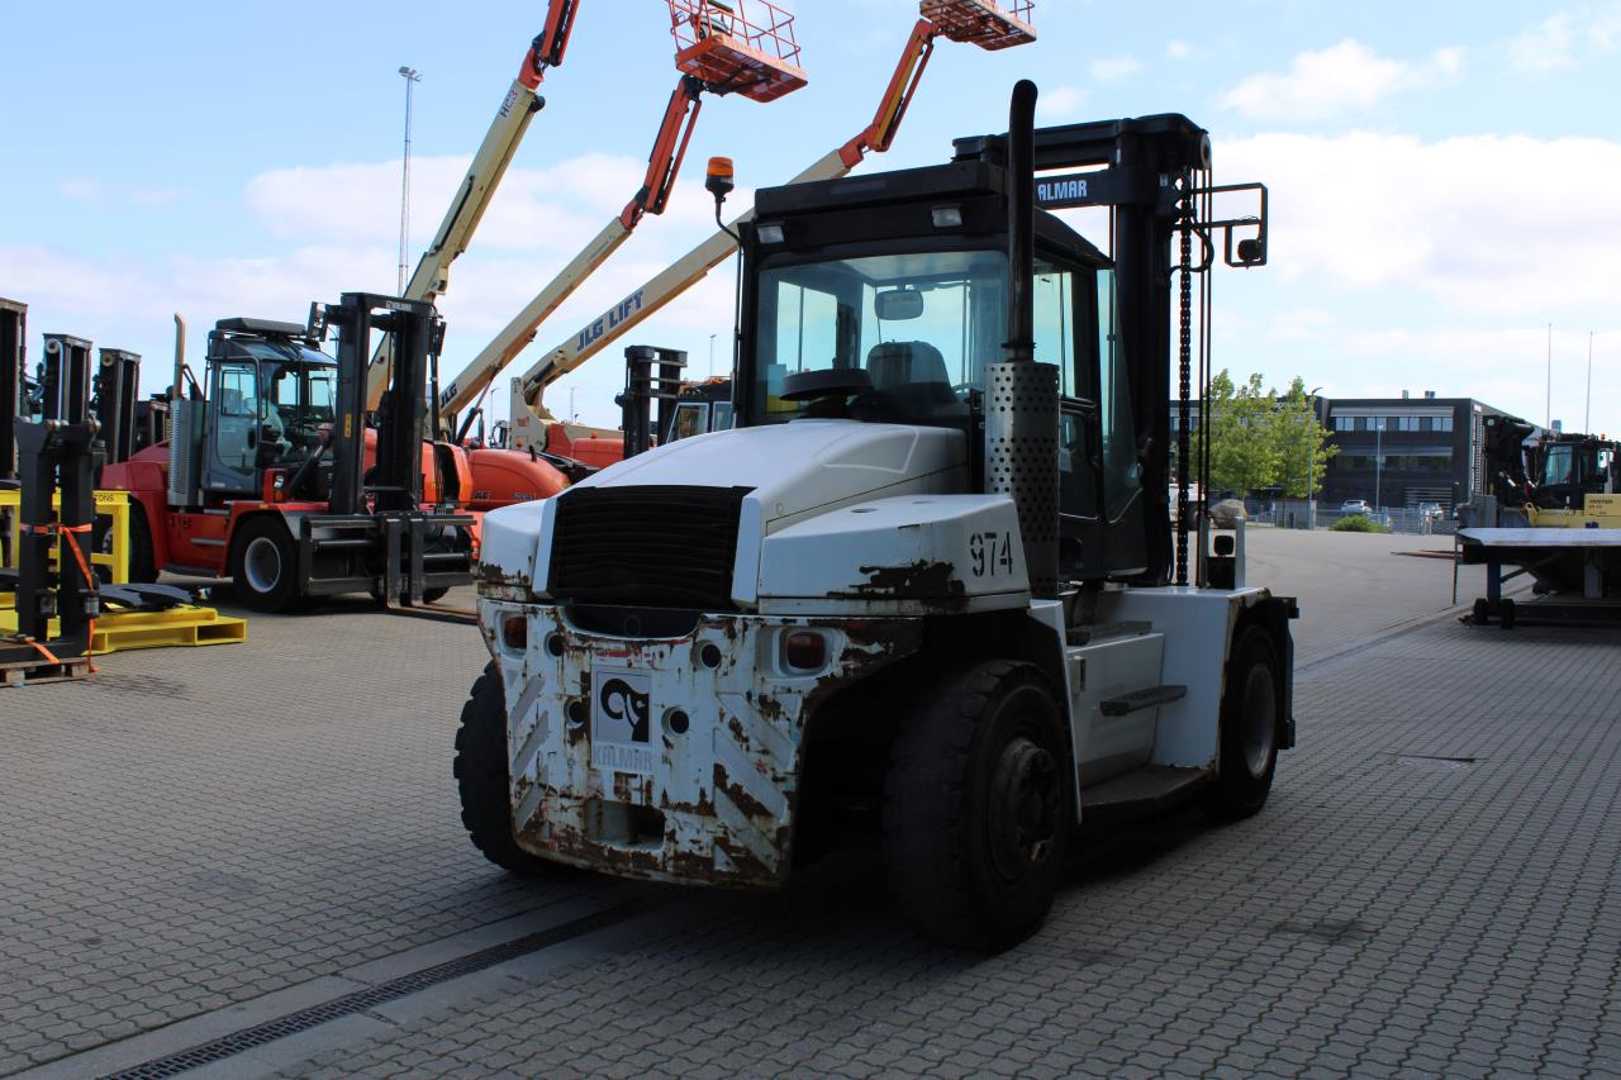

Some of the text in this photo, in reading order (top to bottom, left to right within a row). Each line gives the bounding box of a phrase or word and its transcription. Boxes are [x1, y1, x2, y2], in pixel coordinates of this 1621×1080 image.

[1037, 180, 1088, 201] ALMAR
[577, 290, 644, 352] JLG LIFT
[441, 383, 457, 408] JLG
[970, 531, 1013, 577] 974
